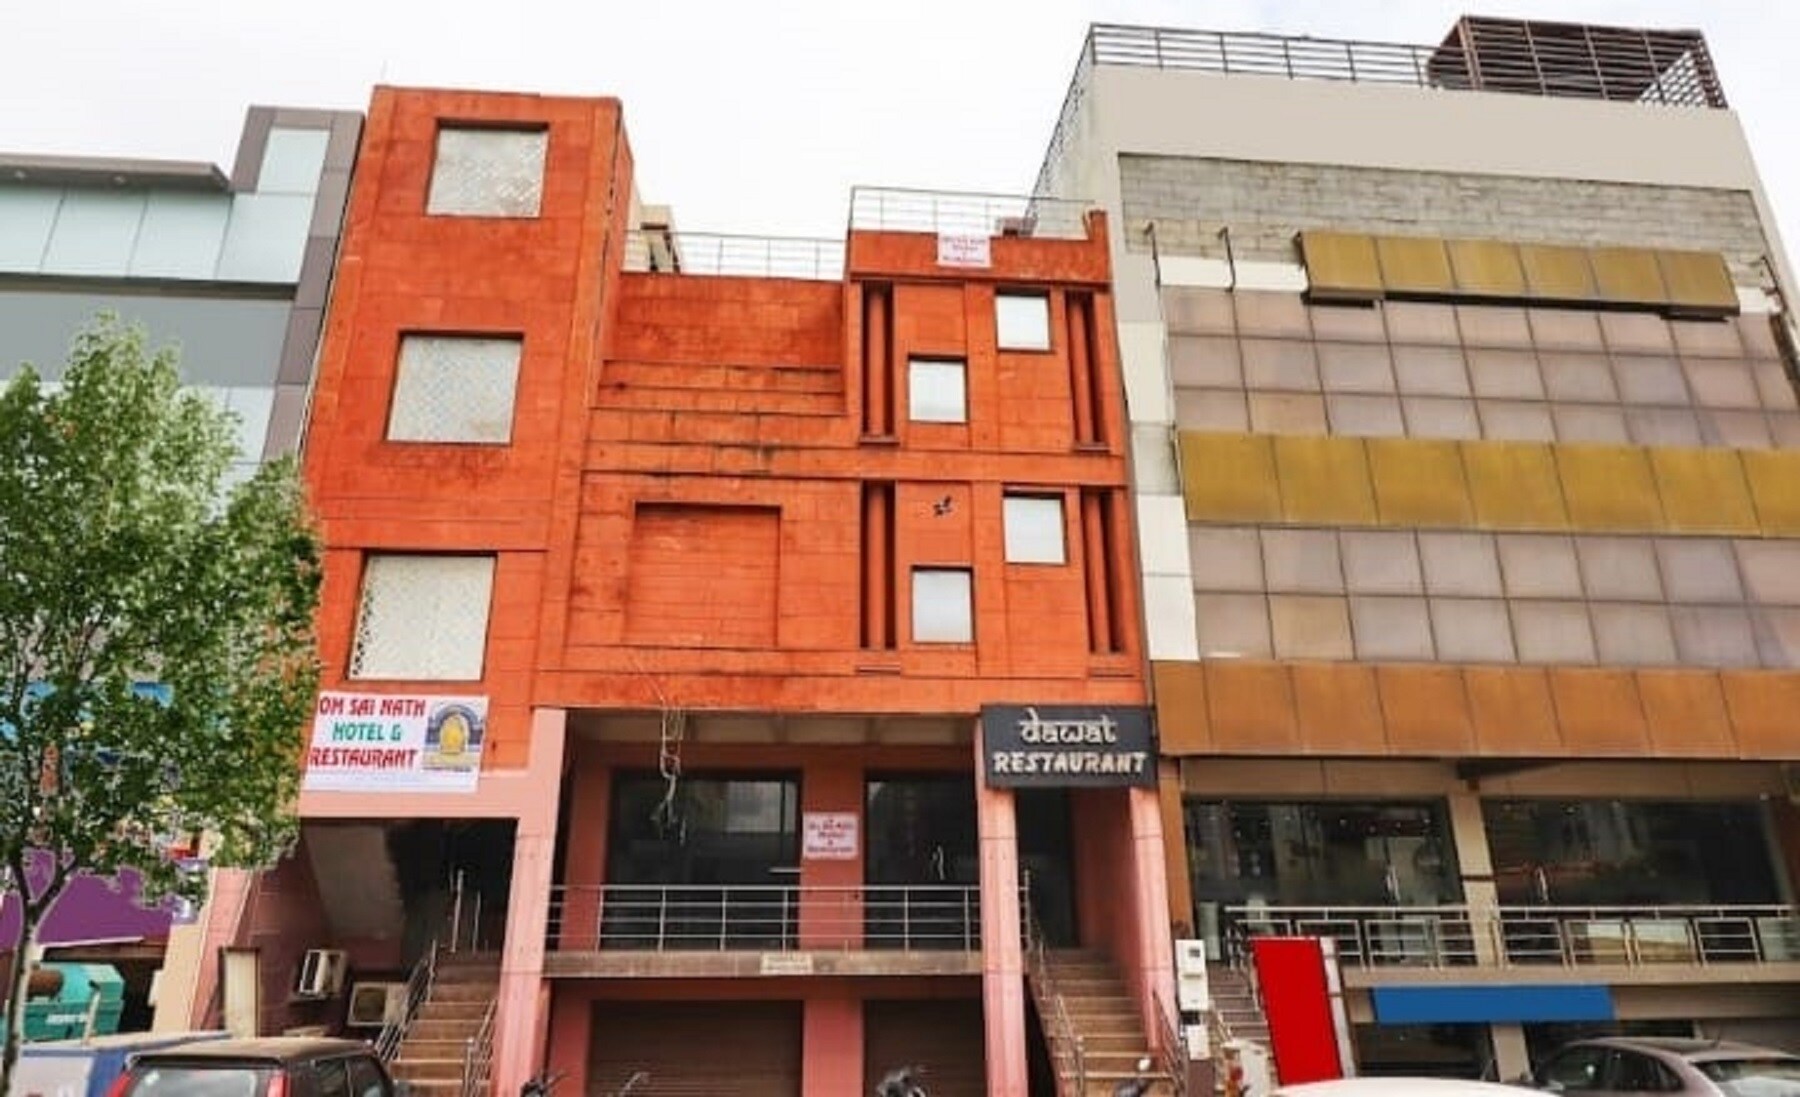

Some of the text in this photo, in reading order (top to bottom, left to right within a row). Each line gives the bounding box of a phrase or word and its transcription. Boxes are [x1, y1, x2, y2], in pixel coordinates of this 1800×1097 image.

[319, 696, 343, 716] OM
[379, 699, 426, 718] NATH
[332, 721, 384, 741] HOTEL
[310, 748, 417, 768] RESTAURANT
[994, 752, 1148, 774] RESTAURANT
